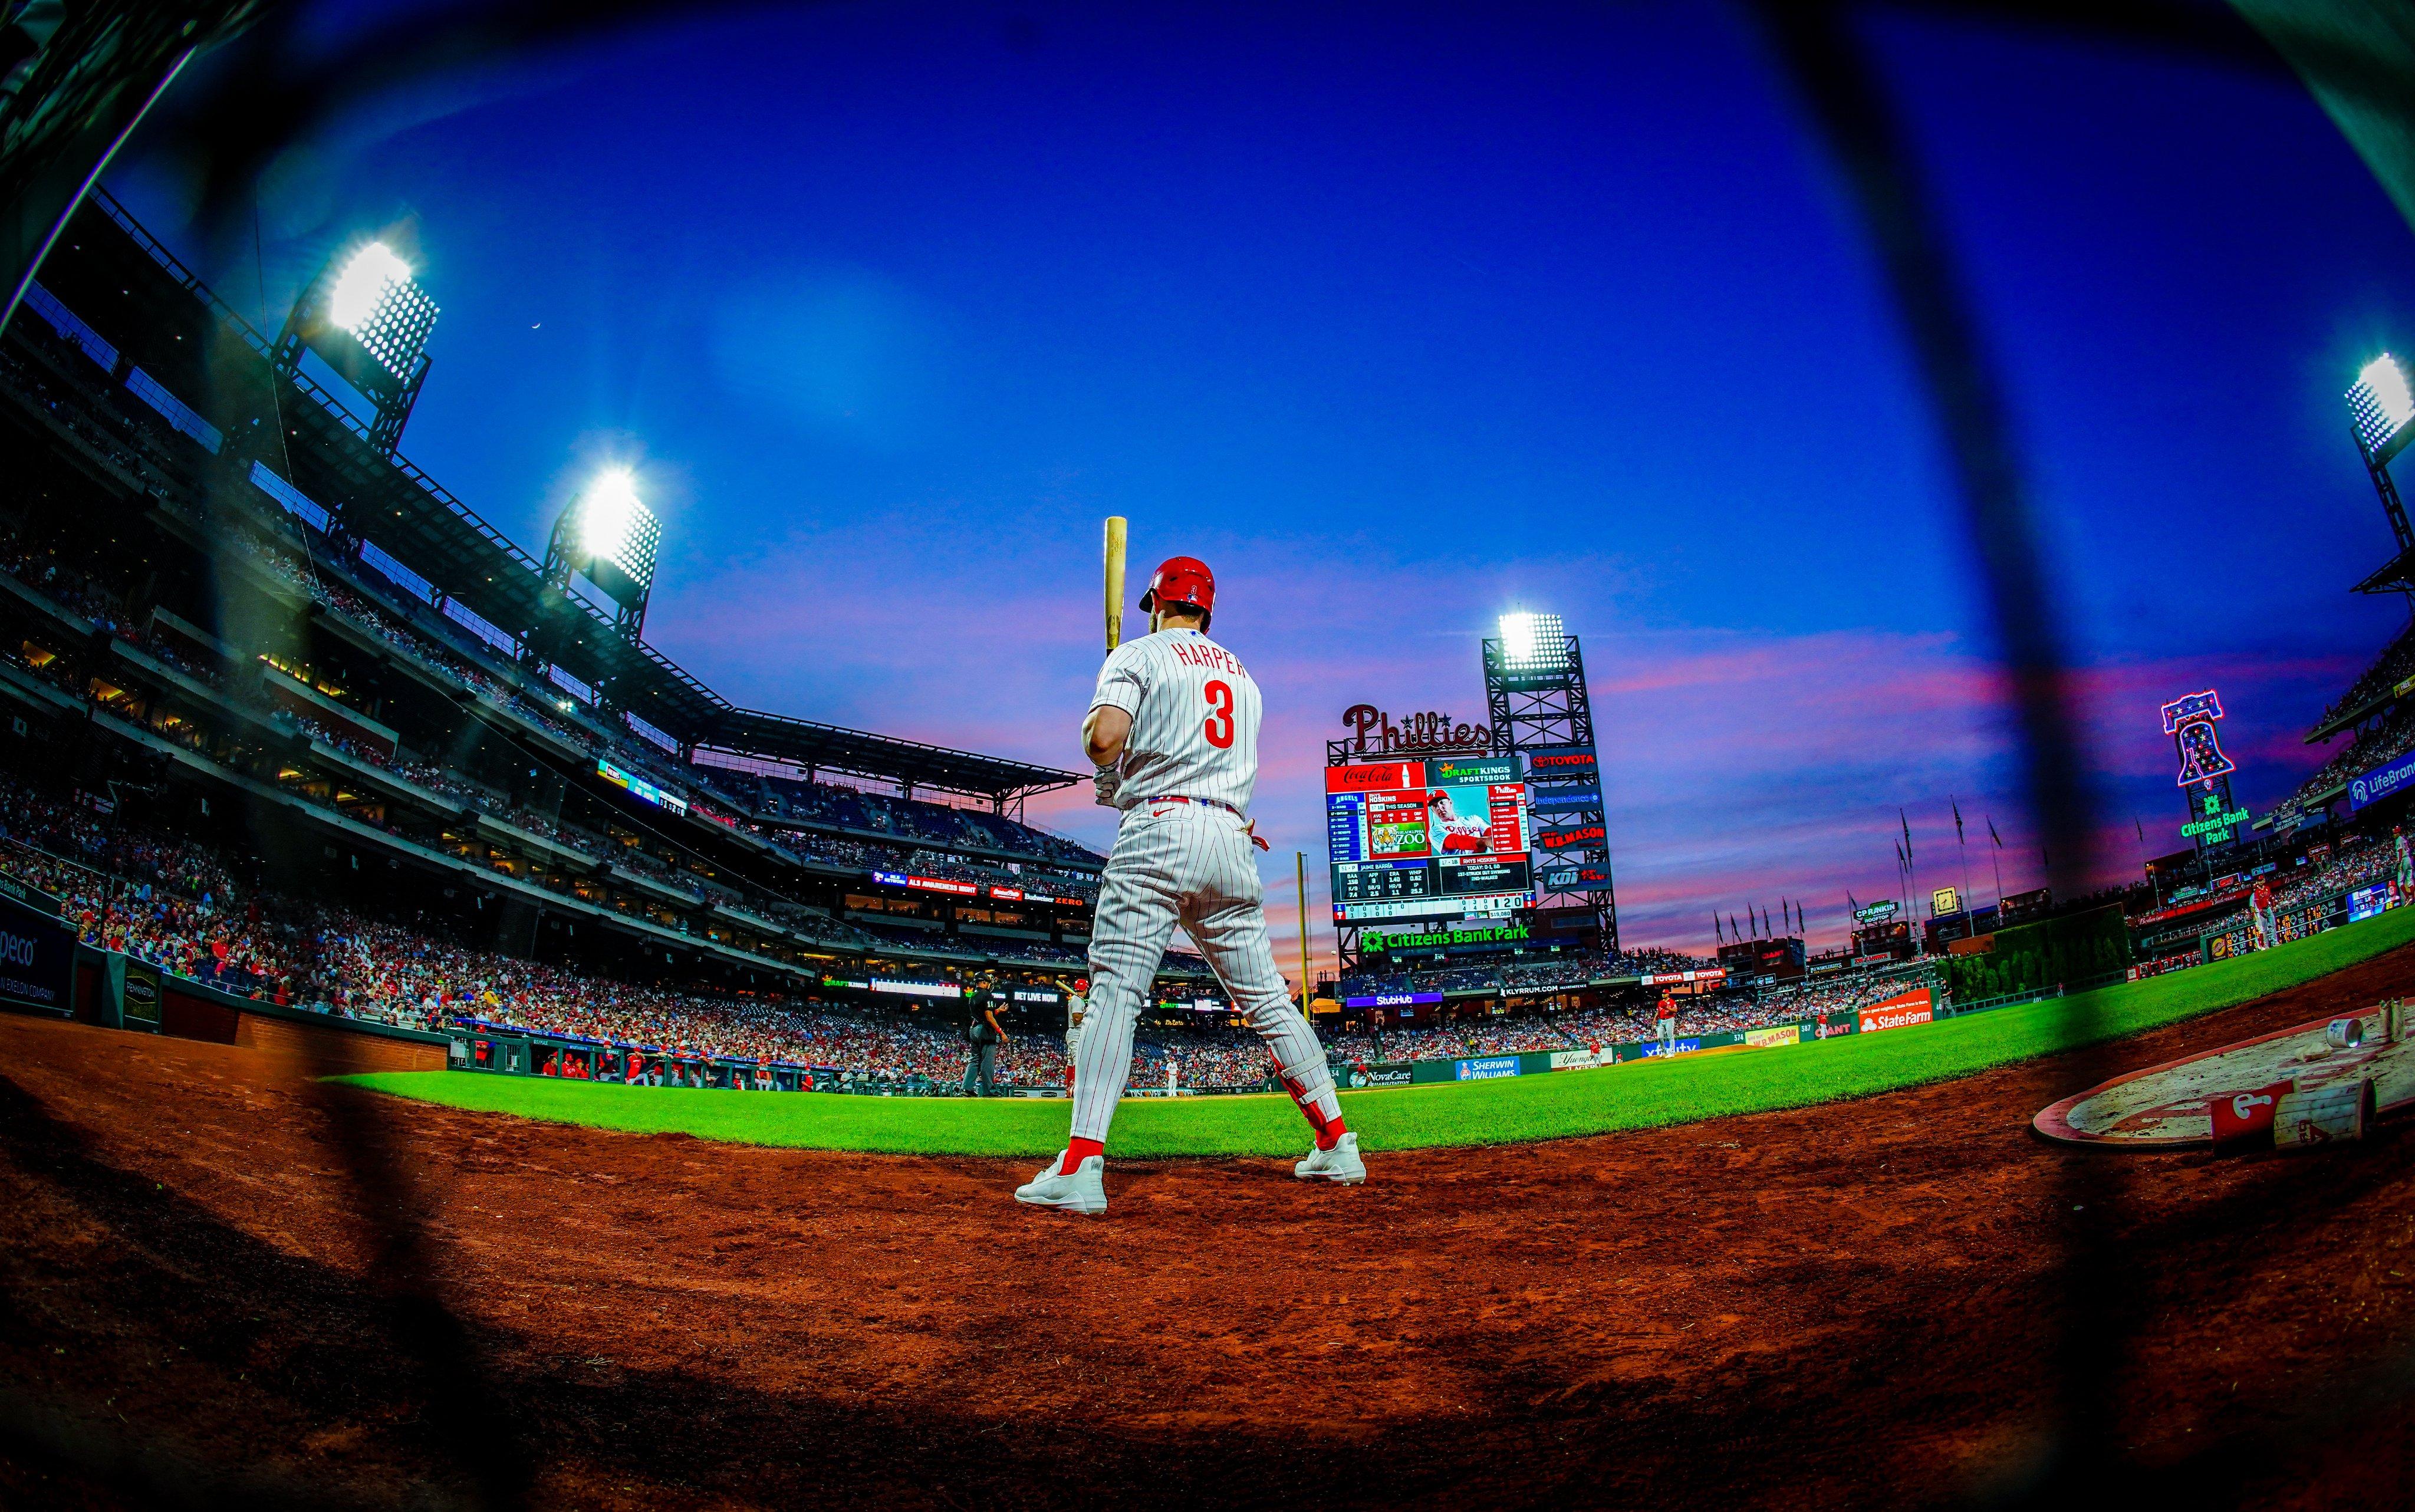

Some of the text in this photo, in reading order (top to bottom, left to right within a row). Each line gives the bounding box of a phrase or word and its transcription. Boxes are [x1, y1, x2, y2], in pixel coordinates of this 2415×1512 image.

[1191, 585, 1197, 594] 3
[1171, 643, 1245, 678] HARPER
[1205, 680, 1234, 749] 3
[1343, 704, 1491, 752] Phillies
[1548, 755, 1594, 766] TOYOTA
[1442, 766, 1511, 778] DRAFTKINGS
[1459, 775, 1511, 783] SPORTSBOOK
[1336, 795, 1358, 803] ANGELS
[1535, 795, 1589, 805] Independence
[2181, 808, 2249, 836] Citizens Bank
[1396, 834, 1425, 844] ZOO
[1544, 827, 1604, 848] W.B.MASON
[2206, 828, 2229, 844] Park
[922, 881, 957, 891] AWARENESS
[4, 884, 26, 900] Bank Park
[1025, 893, 1054, 902] Budweiser
[1055, 897, 1083, 905] ZERO
[1504, 898, 1511, 907] 2
[1515, 898, 1521, 906] 0
[2210, 895, 2237, 905] Budweiser
[1868, 904, 1895, 915] RANKIN
[1864, 915, 1888, 923] ROOFTOP
[2138, 914, 2164, 925] Budweiser
[1387, 924, 1529, 948] Citizens Bank Park
[127, 981, 156, 997] PENNINGTON
[824, 980, 868, 989] DRAFTKINGS
[7, 979, 55, 1002] EXELON COMPANY
[1506, 986, 1558, 995] KLYRRUM.COM
[1014, 992, 1028, 1000] BET
[1028, 993, 1041, 1002] LIVE
[1042, 993, 1058, 1002] NOW
[1376, 995, 1412, 1005] StubHub
[1815, 1024, 1851, 1037] GANT
[1473, 1060, 1514, 1070] SHERWIN
[1369, 1071, 1410, 1081] NovaCare
